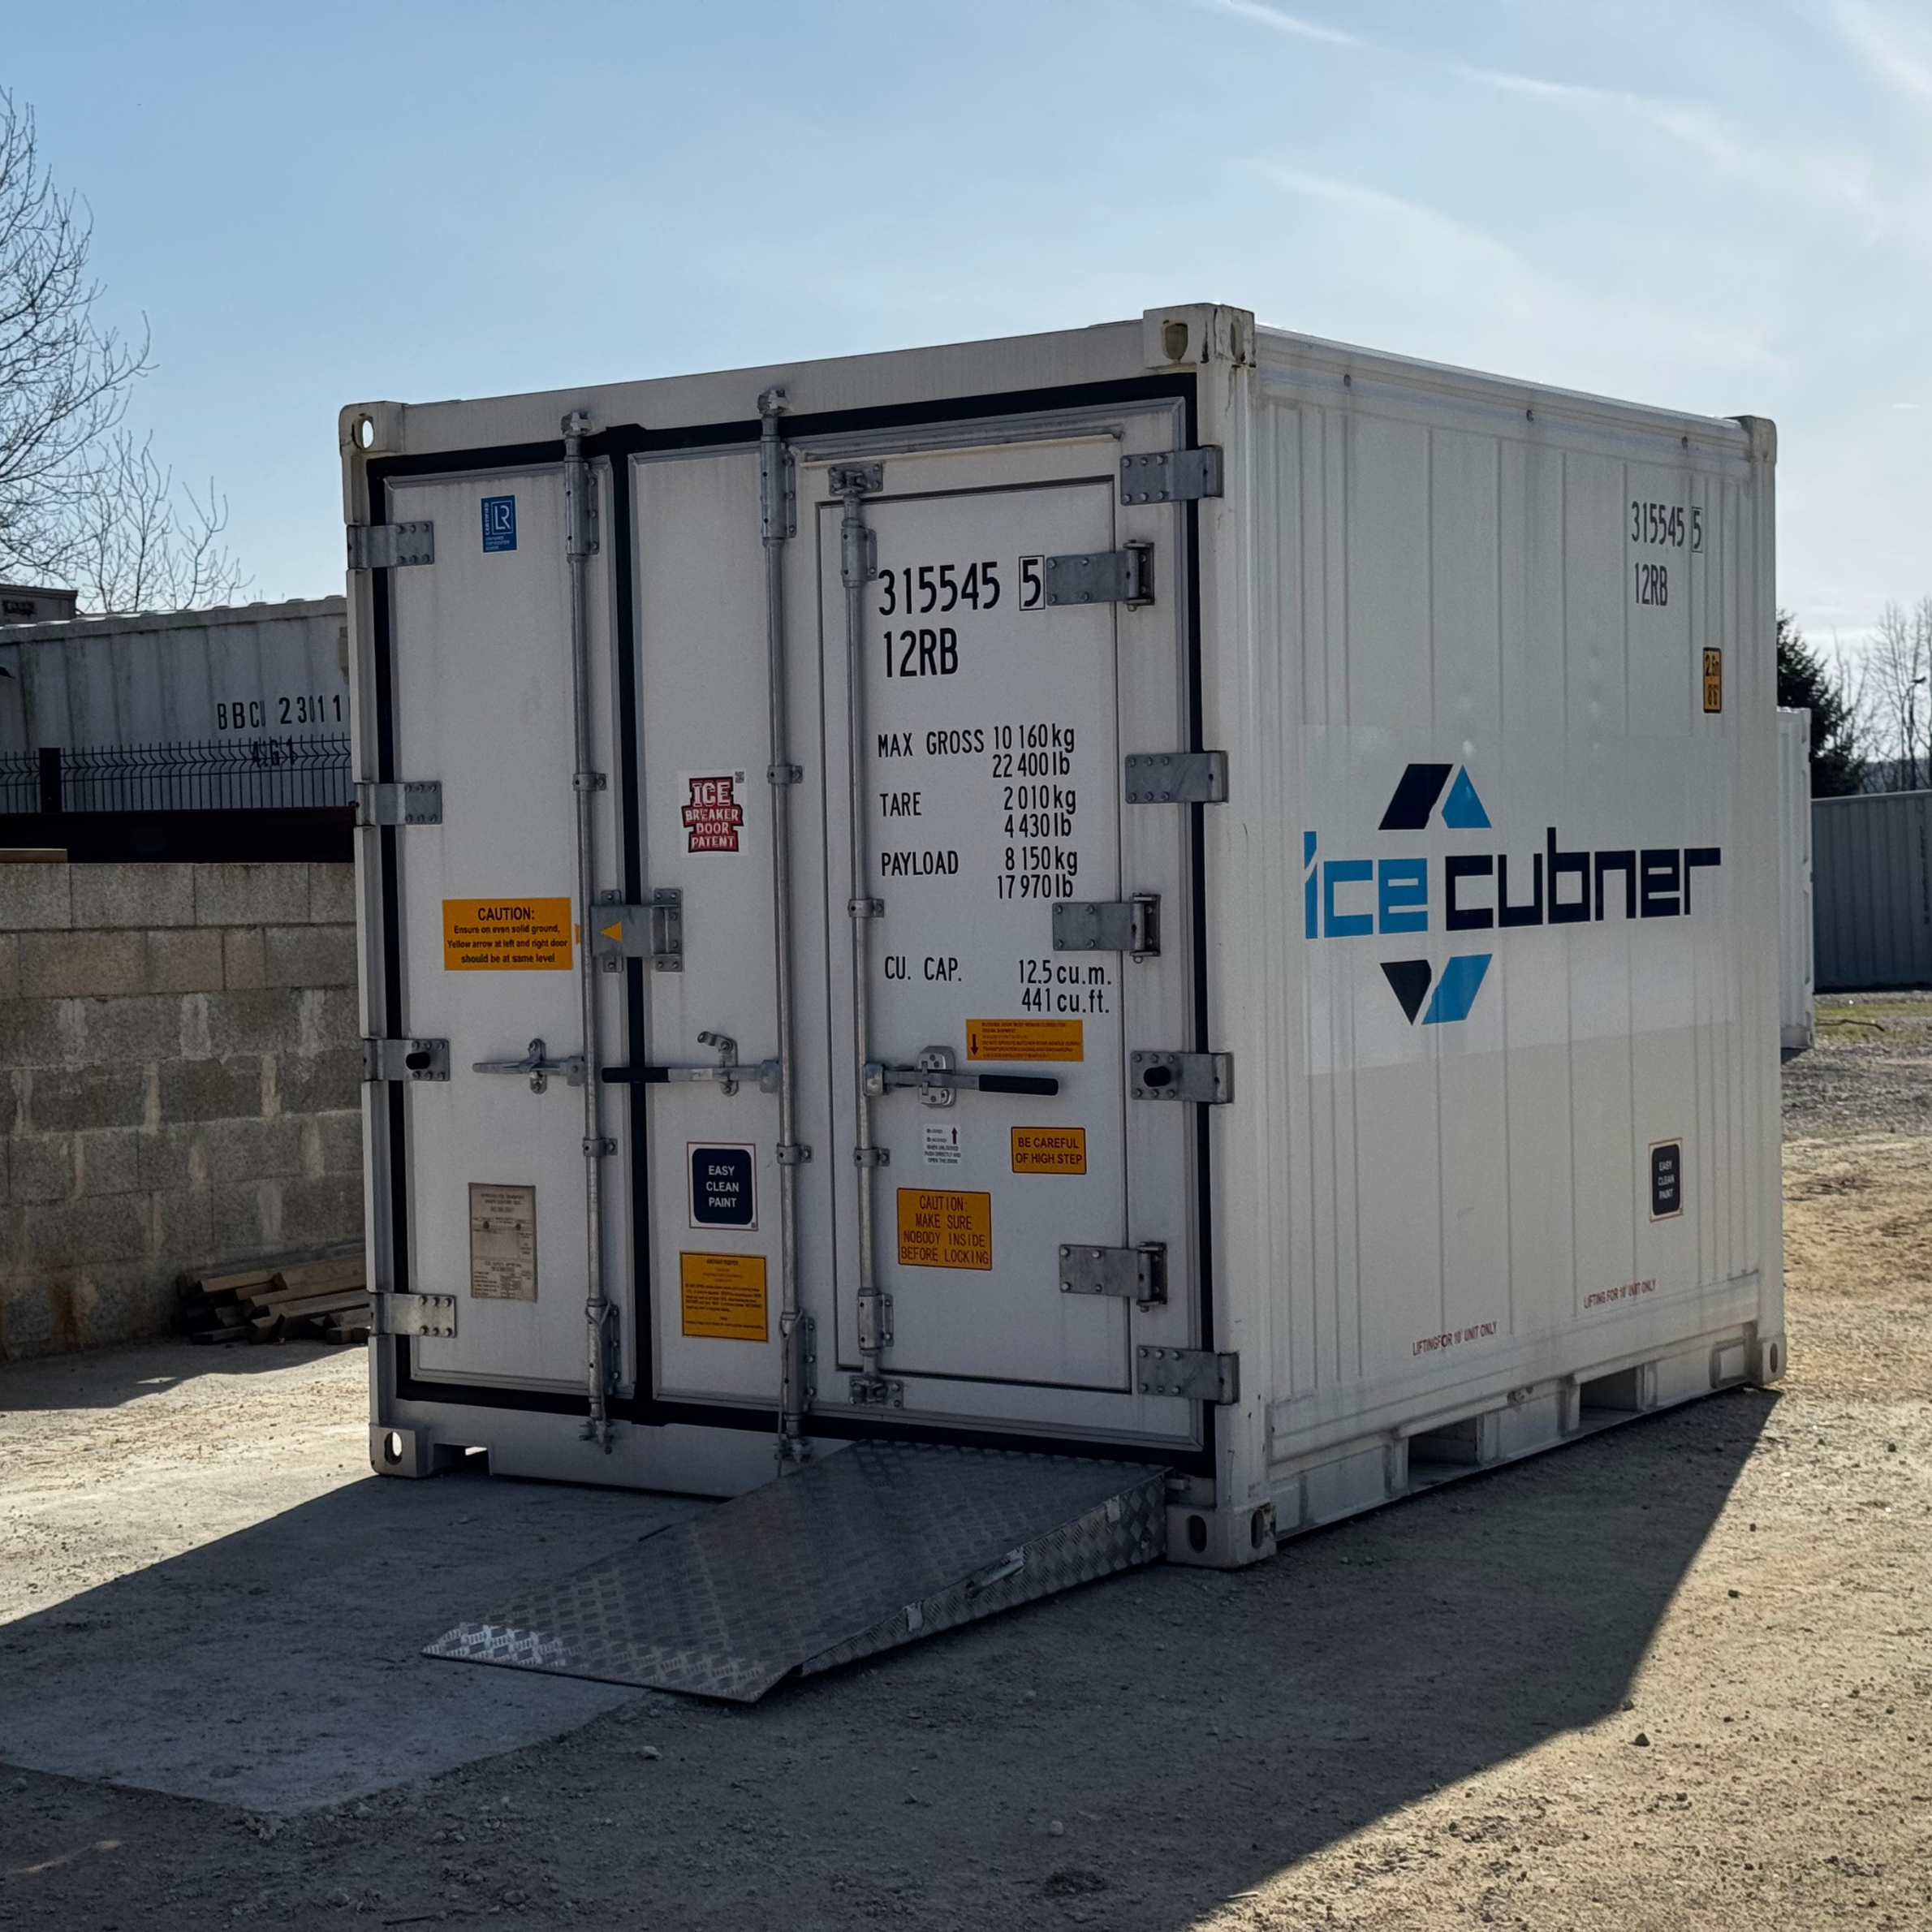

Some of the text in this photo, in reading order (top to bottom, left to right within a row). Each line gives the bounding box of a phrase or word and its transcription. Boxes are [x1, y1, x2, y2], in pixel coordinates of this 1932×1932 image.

[494, 505, 511, 530] LR
[1631, 501, 1701, 550] 315545 5
[878, 558, 1041, 615] 315545 5
[1635, 563, 1668, 606] 12RB
[883, 627, 959, 678] 12RB
[278, 694, 350, 724] 23011
[878, 732, 914, 758] MAX
[926, 729, 985, 755] GROSS
[692, 782, 731, 807] ICE
[879, 792, 921, 817] TARE
[684, 808, 740, 823] BREAKER
[696, 822, 730, 834] DOOR
[691, 836, 735, 849] PATENT
[882, 851, 959, 876] PAYLOAD
[478, 908, 535, 921] CAUTION:
[454, 925, 480, 934] Ensure
[511, 925, 530, 933] solid
[447, 940, 471, 948] Yellow
[503, 939, 515, 947] left
[516, 939, 530, 947] and
[532, 938, 549, 949] right
[550, 938, 568, 947] door
[461, 953, 555, 963] should be at same level
[884, 956, 912, 980] CU.
[924, 957, 963, 981] CAP.
[1018, 1137, 1079, 1149] BE CAREFUL
[1016, 1153, 1083, 1165] OF HIGH STEP
[709, 1165, 735, 1175] EASY
[705, 1181, 740, 1192] CLEAN
[709, 1197, 737, 1208] PAINT
[920, 1195, 968, 1212] CAUTION:
[915, 1213, 972, 1231] MAKE SURE
[903, 1231, 985, 1248] NOBODY INSIDE
[901, 1246, 989, 1265] BEFORE LOCKING
